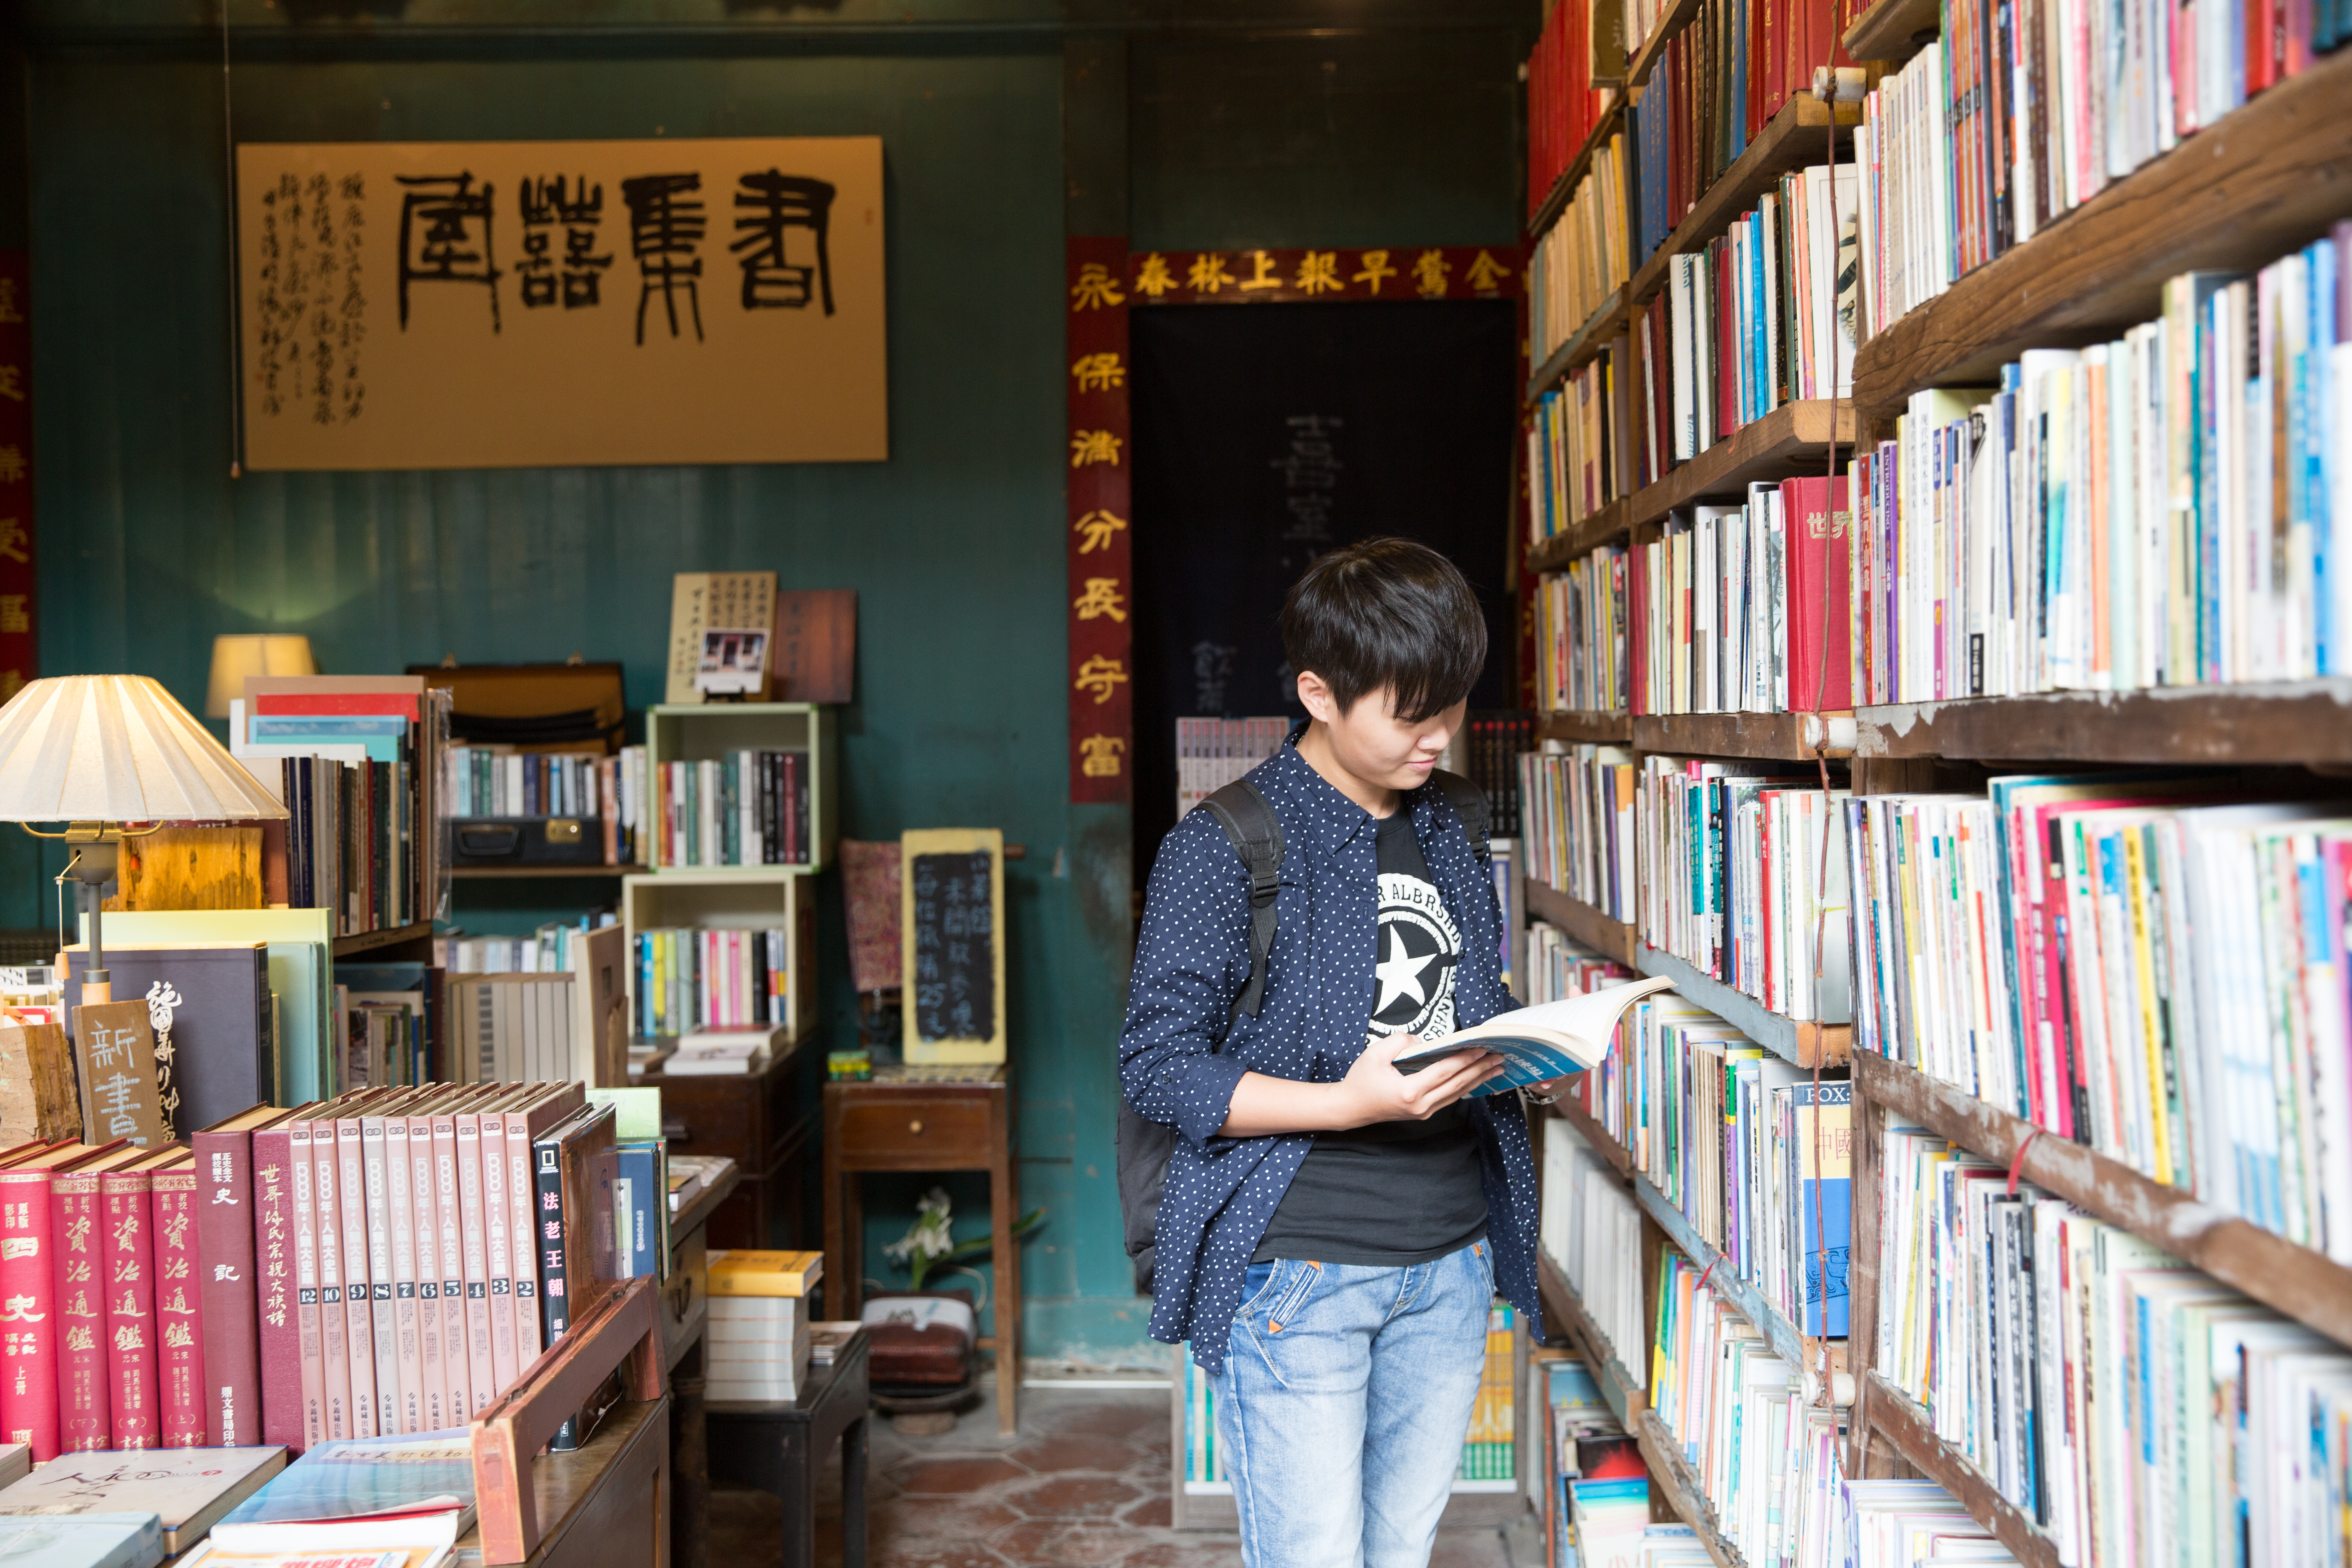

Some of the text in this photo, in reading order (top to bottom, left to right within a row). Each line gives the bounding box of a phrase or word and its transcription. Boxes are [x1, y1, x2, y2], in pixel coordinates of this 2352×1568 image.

[222, 1152, 233, 1183] 正史全文
[4, 1203, 15, 1229] 影印
[18, 1202, 29, 1228] 原版
[212, 1187, 241, 1282] 史記
[543, 1192, 564, 1297] 法老王朝
[0, 1237, 46, 1322] 四史
[65, 1215, 98, 1351] 資治通鑑
[113, 1214, 147, 1351] 資治通鑑
[163, 1212, 195, 1348] 資治通鑑
[350, 1284, 366, 1298] 9
[374, 1285, 390, 1300] 8
[398, 1283, 413, 1297] 7
[421, 1284, 437, 1298] 6
[445, 1281, 460, 1296] 5
[470, 1284, 484, 1298] 4
[493, 1279, 509, 1294] 3
[518, 1282, 534, 1296] 2
[300, 1290, 317, 1303] 12
[323, 1289, 340, 1302] 10
[15, 1365, 26, 1395] 上冊
[361, 1404, 369, 1439] 錦繡出版
